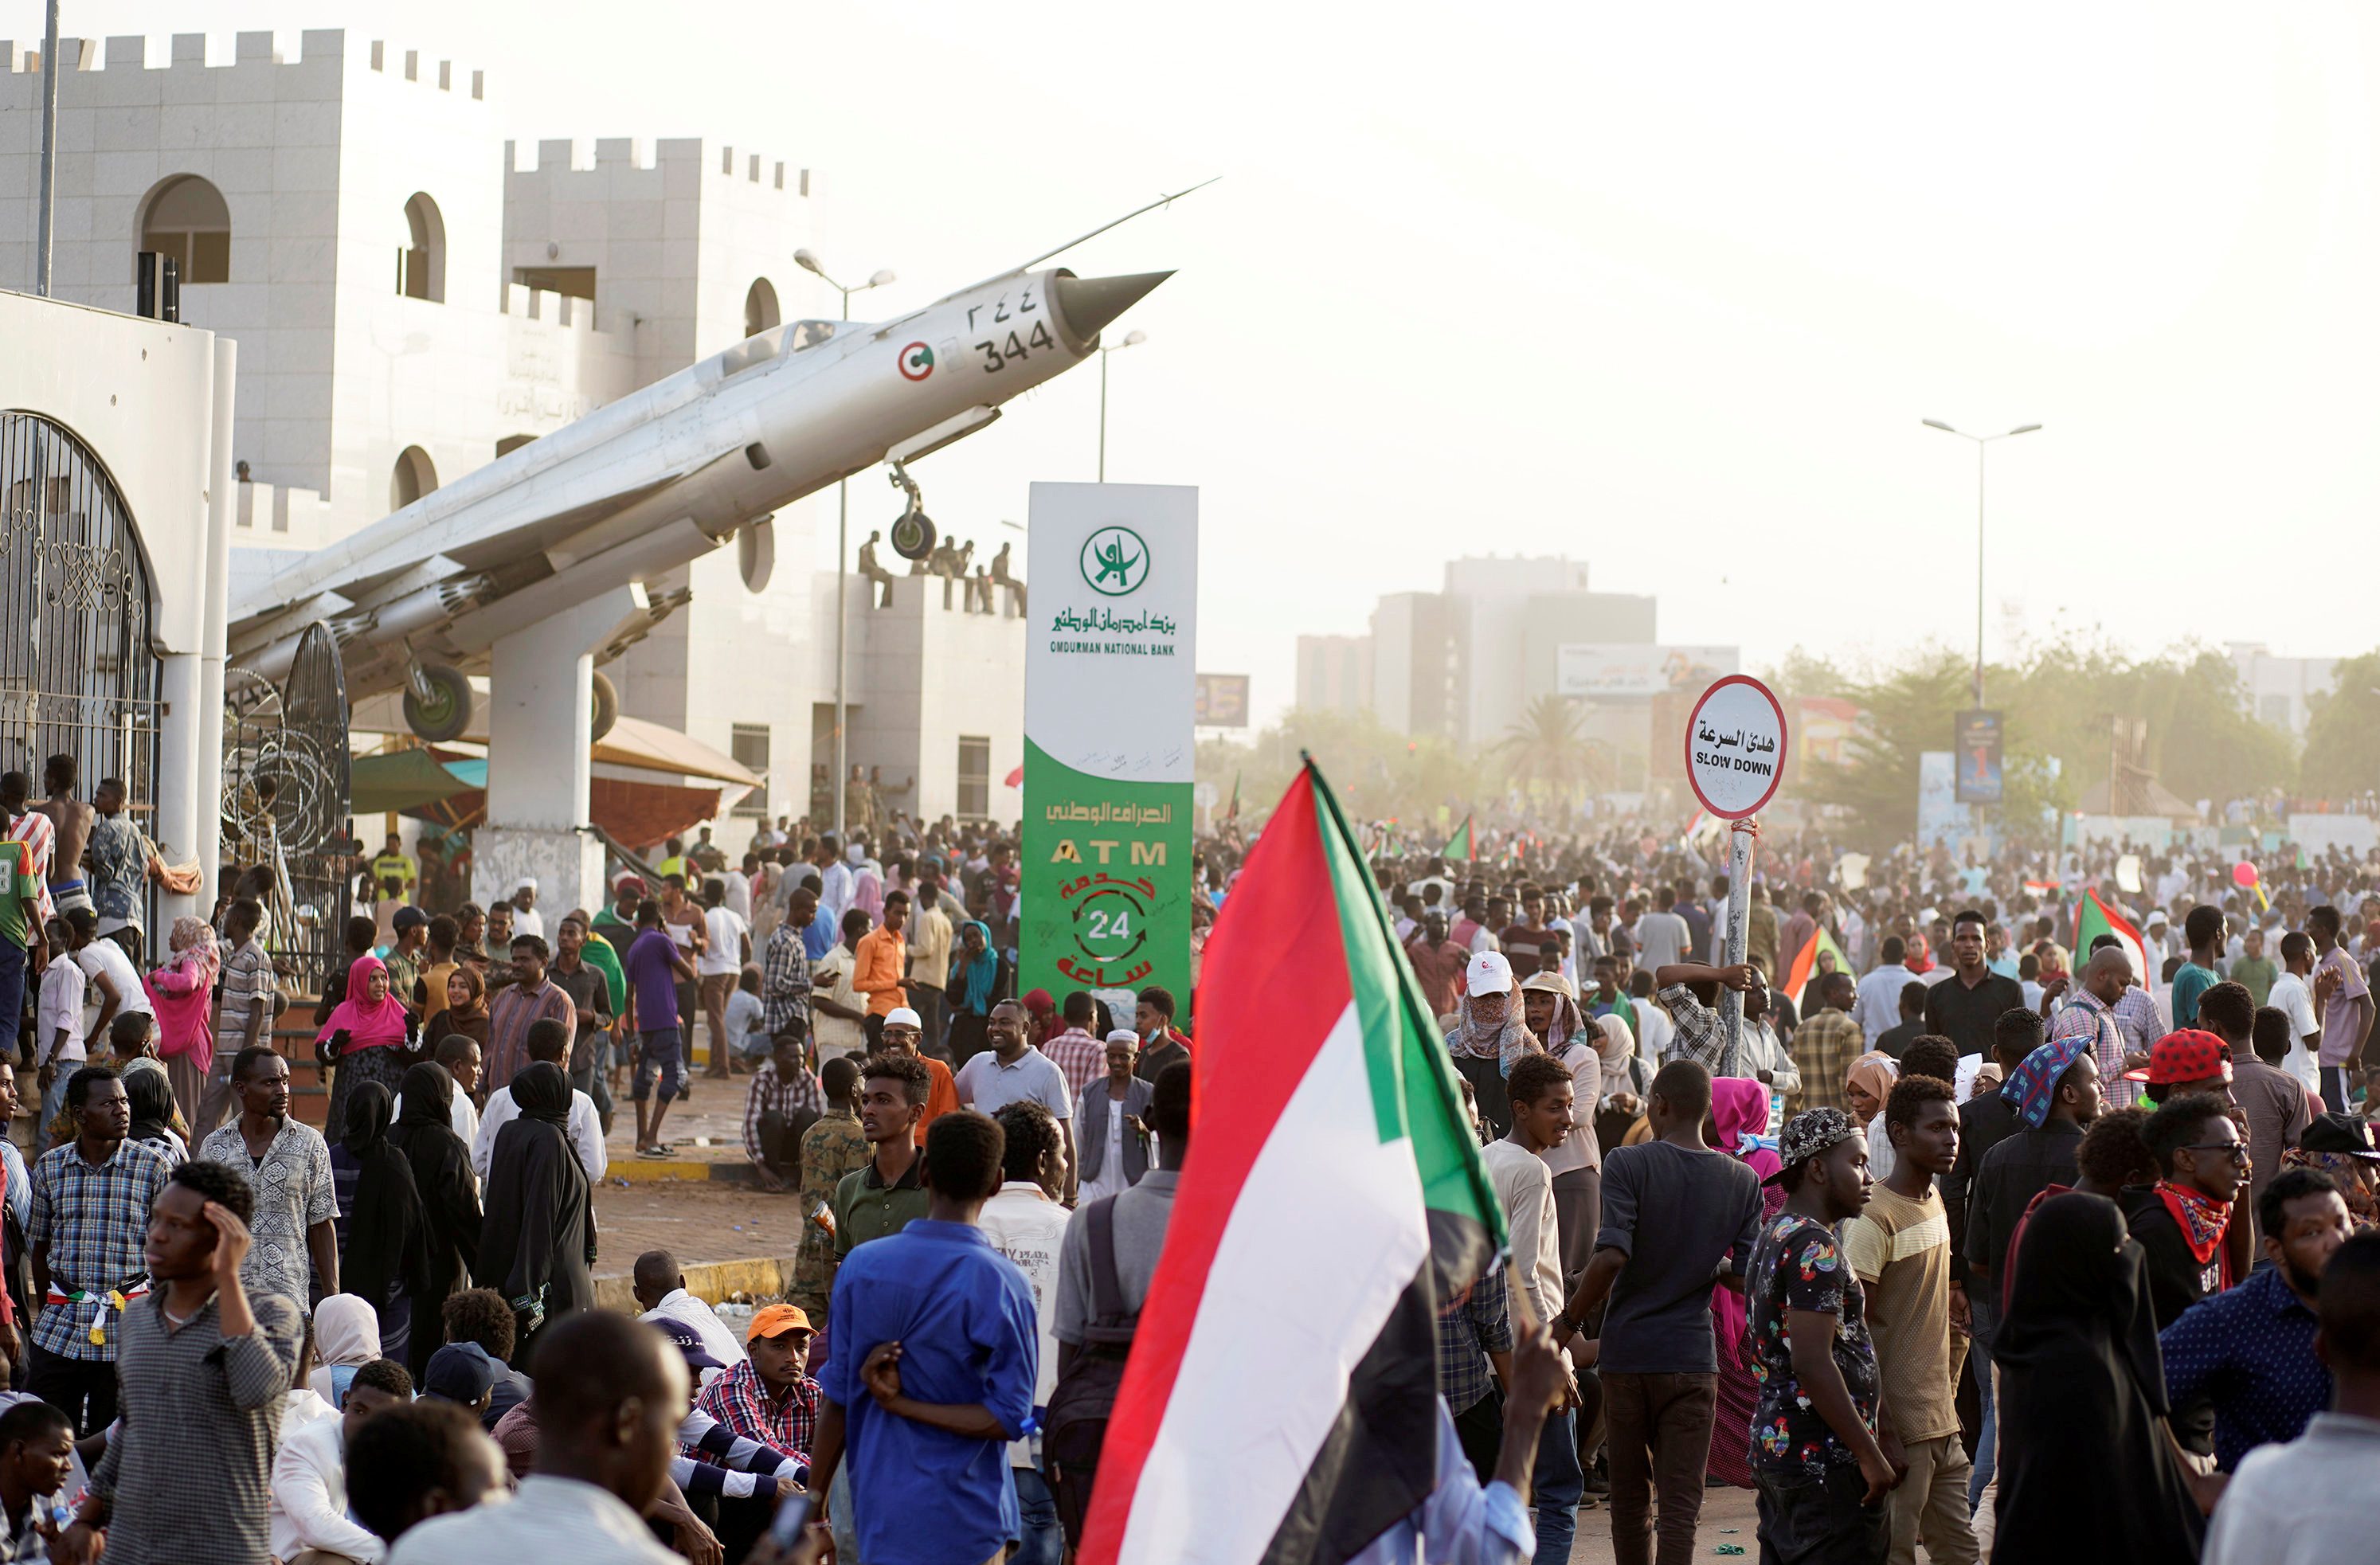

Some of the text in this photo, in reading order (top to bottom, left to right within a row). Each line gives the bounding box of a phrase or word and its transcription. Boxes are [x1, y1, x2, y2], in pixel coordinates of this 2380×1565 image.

[975, 319, 1055, 374] 344
[1051, 605, 1098, 633] الوطني
[1149, 612, 1176, 636] بنك
[1050, 641, 1176, 657] OMDURMAN NATIONAL BANK
[1698, 719, 1745, 749] السرعة
[1696, 751, 1772, 777] SLOW DOWN
[1046, 799, 1172, 828] الصراف الوطني
[1050, 839, 1167, 867] ATM
[1058, 872, 1157, 901] خدمة
[1088, 910, 1130, 940] 24
[1056, 953, 1153, 988] ساعة
